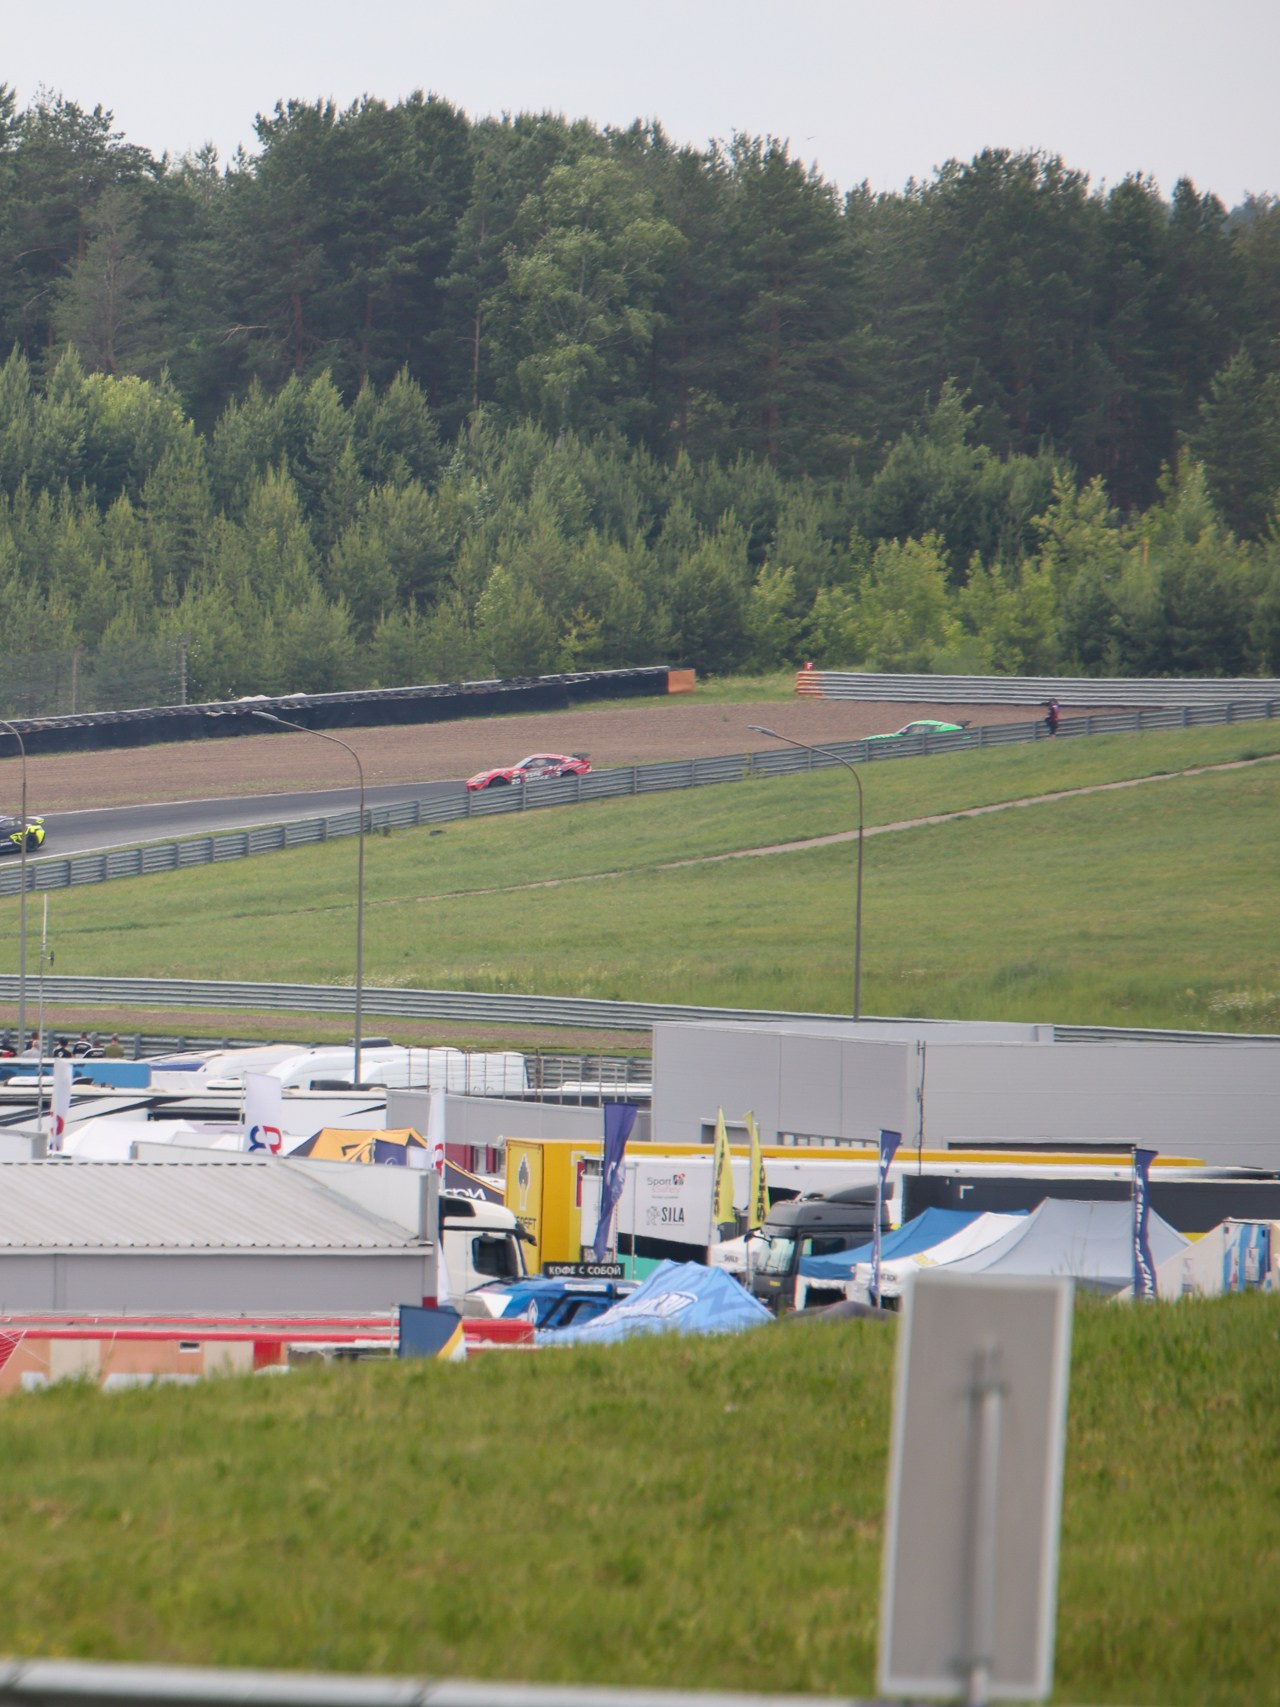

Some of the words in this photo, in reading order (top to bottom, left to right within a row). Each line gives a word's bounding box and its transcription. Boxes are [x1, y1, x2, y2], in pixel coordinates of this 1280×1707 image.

[646, 1176, 671, 1187] Sport
[661, 1206, 685, 1223] SILA
[548, 1265, 576, 1275] КОФЕ
[579, 1265, 585, 1275] С
[587, 1264, 621, 1275] СОБОЙ
